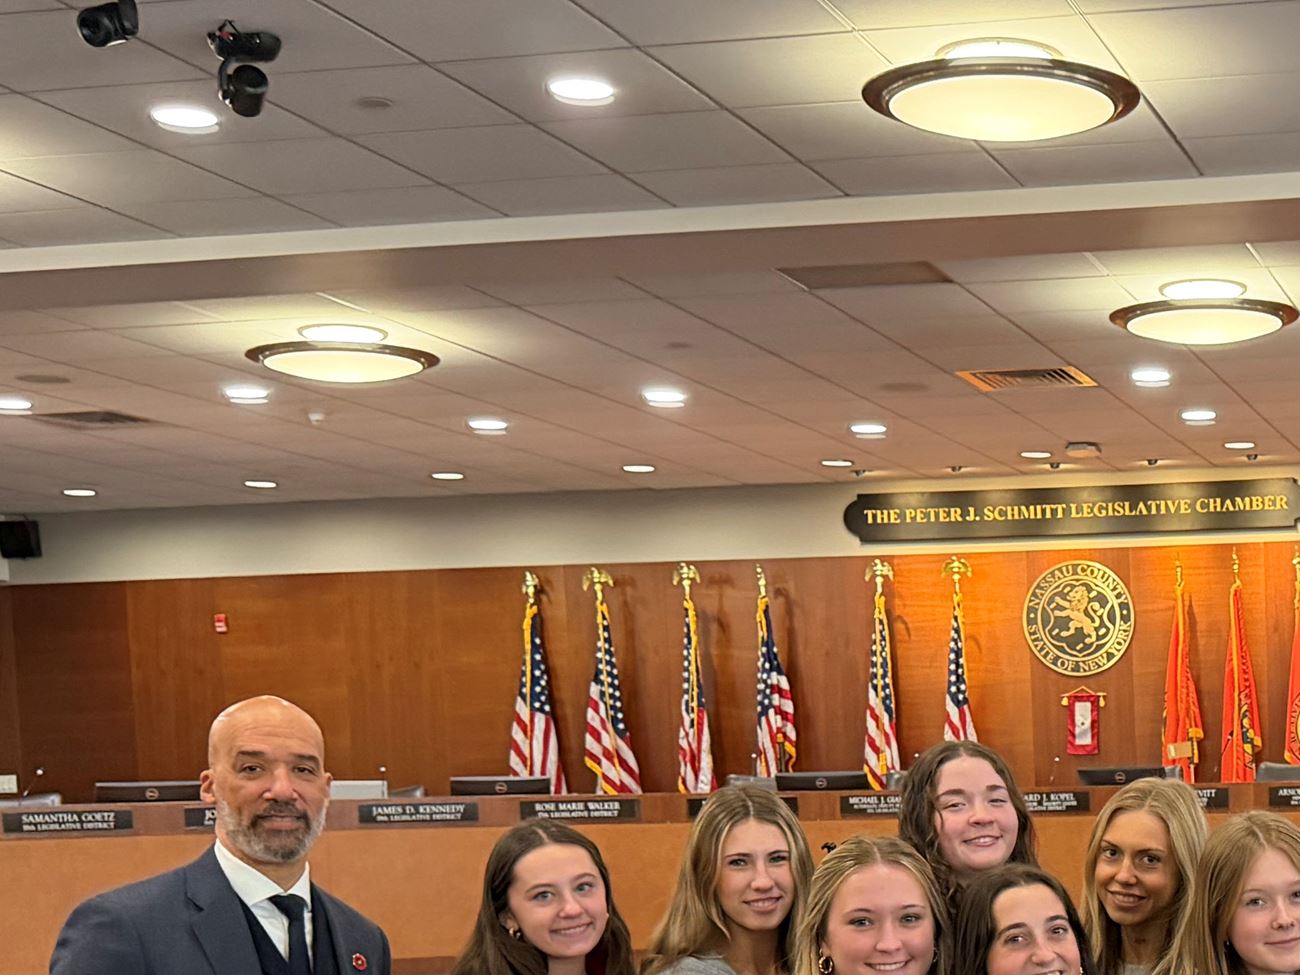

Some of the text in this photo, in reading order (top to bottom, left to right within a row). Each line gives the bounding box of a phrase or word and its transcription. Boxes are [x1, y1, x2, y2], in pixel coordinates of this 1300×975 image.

[864, 494, 1289, 525] THE PETER J. SCHMITT LEGISLATIVE CHAMBER
[1029, 564, 1129, 608] NASSAU COUNTY
[1028, 621, 1132, 673] STATE OF NEW YORK
[849, 796, 879, 804] MICHAEL
[1050, 793, 1075, 801] KOPEL
[372, 804, 465, 815] JAMES D. KENNEDY
[535, 801, 620, 812] ROSE MARIE WALKER
[21, 812, 115, 824] SAMANTHA GOETZ
